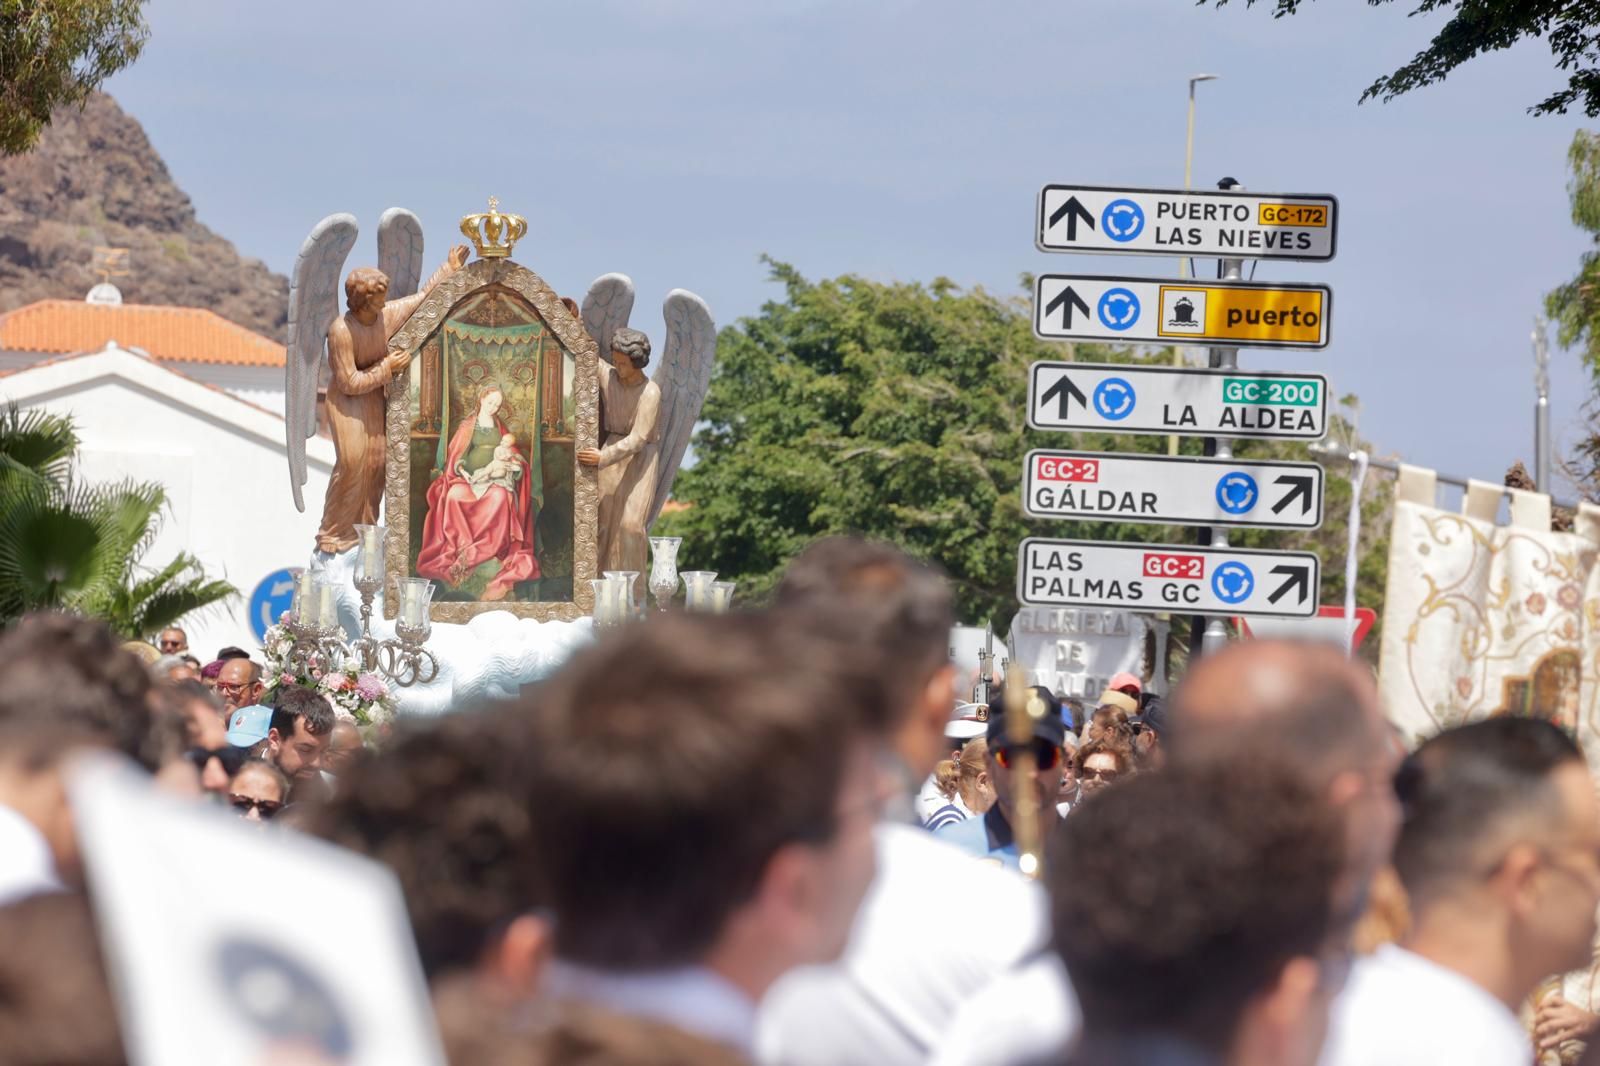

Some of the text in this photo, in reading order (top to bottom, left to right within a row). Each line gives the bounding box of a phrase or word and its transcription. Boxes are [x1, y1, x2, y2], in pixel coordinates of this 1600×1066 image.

[1156, 201, 1250, 222] PUERTO
[1262, 207, 1323, 223] GC-172
[1155, 226, 1312, 249] LAS NIEVES
[1227, 306, 1318, 328] puerto
[1226, 382, 1315, 402] GC-200
[1163, 404, 1316, 431] LA ALDEA
[1040, 460, 1096, 480] GC-2
[1035, 484, 1158, 513] GÁLDAR
[1031, 550, 1083, 571] LAS
[1145, 556, 1202, 576] GC-2
[1031, 576, 1200, 603] PALMAS GC
